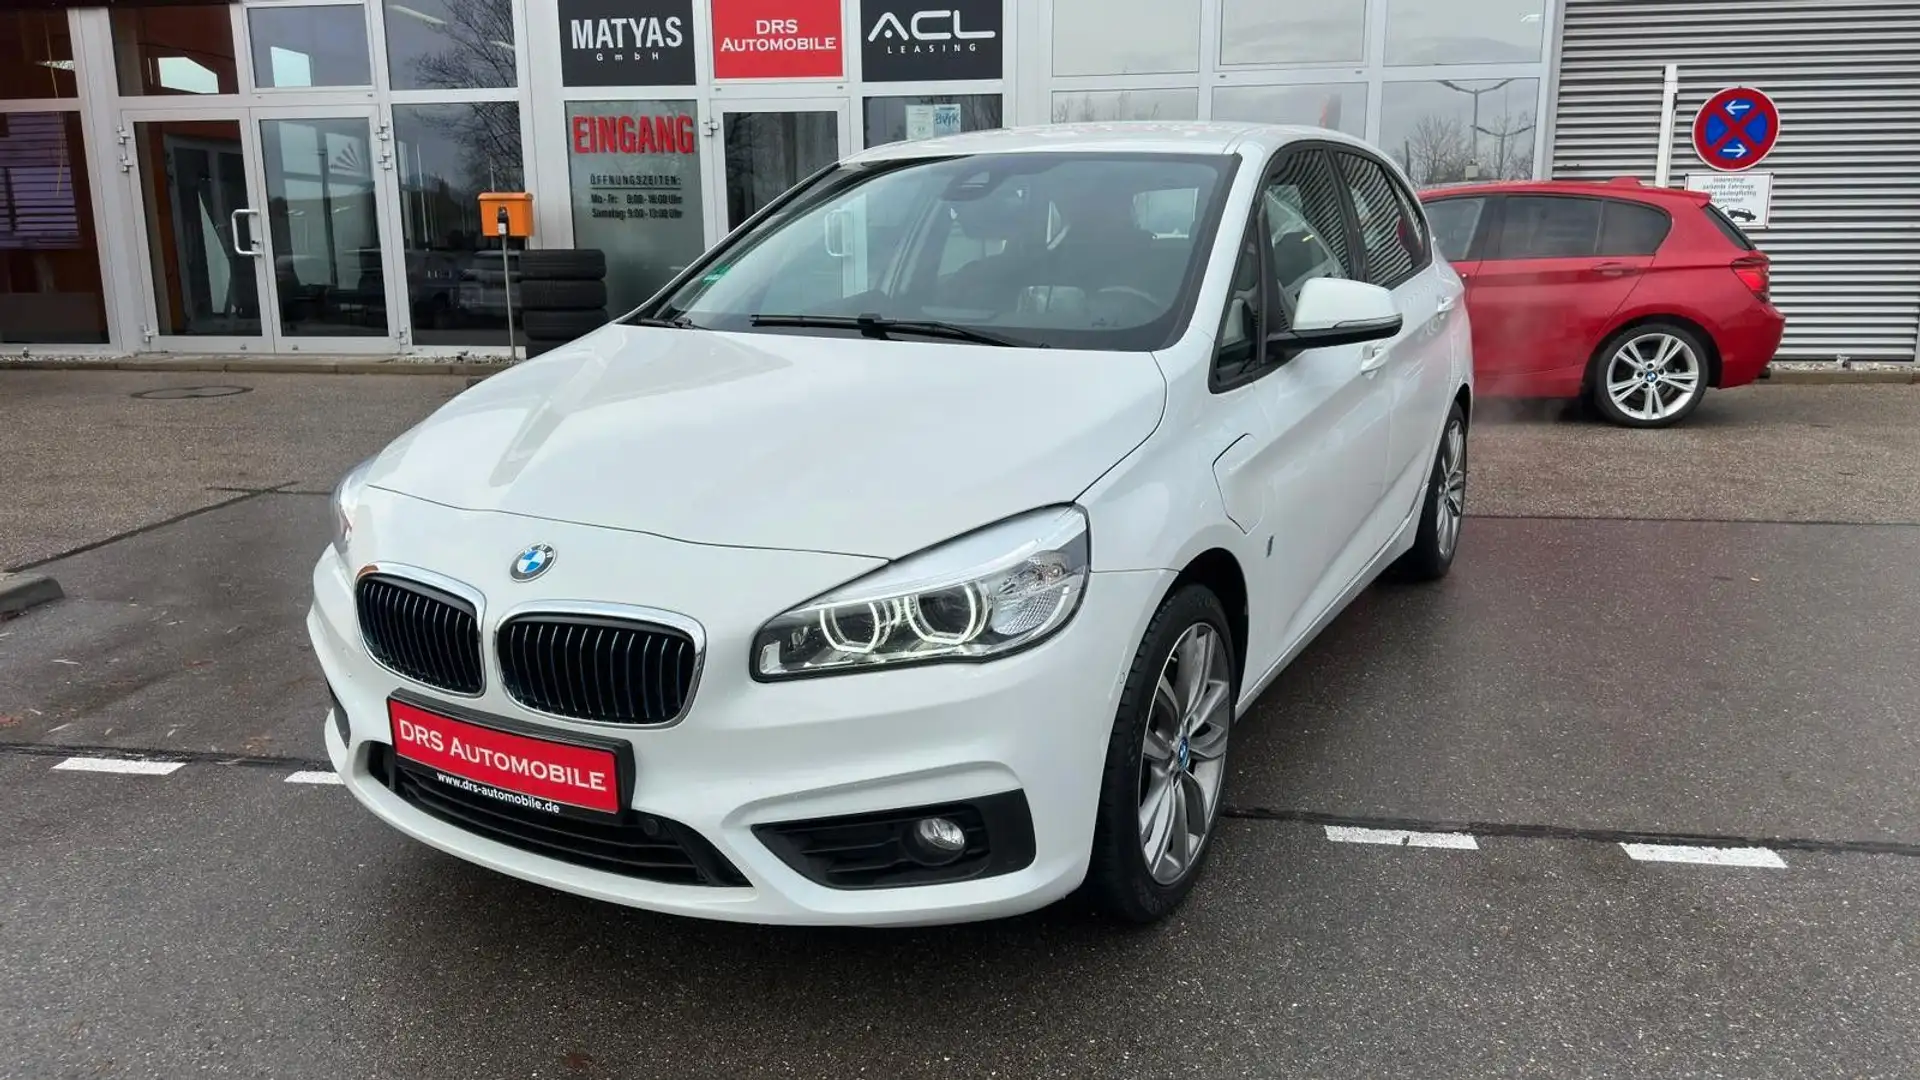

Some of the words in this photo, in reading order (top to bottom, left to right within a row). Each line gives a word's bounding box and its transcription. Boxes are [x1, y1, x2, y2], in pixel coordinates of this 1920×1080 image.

[570, 16, 683, 49] MATYAS
[755, 19, 799, 35] DRS
[867, 9, 996, 42] ACL
[720, 36, 837, 52] AUTOMOBILE
[887, 43, 976, 54] LEASING
[596, 51, 659, 62] GmbH
[573, 114, 695, 154] EINGANG
[590, 173, 682, 186] ÖFFNUNGSZEITEN:
[398, 719, 445, 752] DRS
[449, 736, 607, 791] AUTOMOBILE
[437, 771, 561, 814] www.drs-automobile.de
